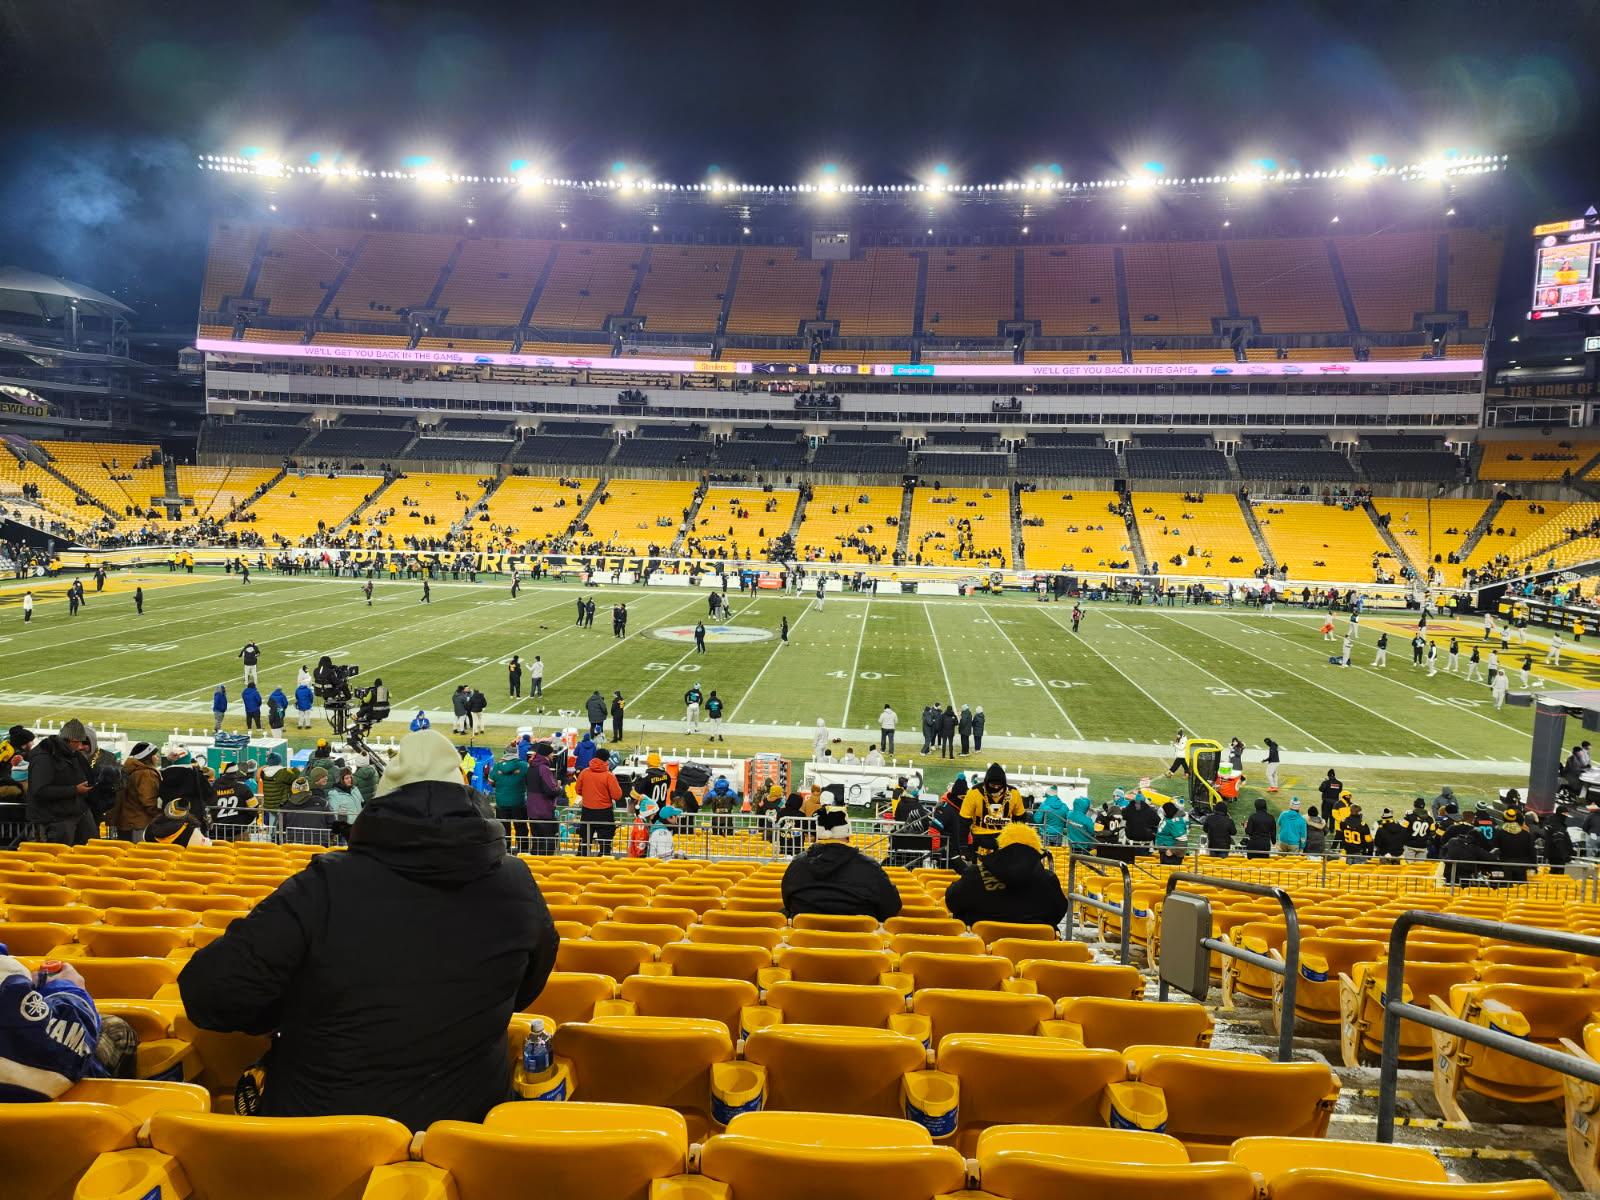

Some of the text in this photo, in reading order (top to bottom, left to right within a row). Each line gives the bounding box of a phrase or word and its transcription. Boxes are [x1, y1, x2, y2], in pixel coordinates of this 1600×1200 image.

[334, 348, 351, 357] GET
[355, 349, 373, 358] YOU
[376, 350, 400, 359] BACK
[402, 351, 412, 359] IN
[414, 352, 431, 360] THE
[1083, 366, 1102, 374] YOU
[1105, 366, 1130, 374] BACK
[1132, 366, 1143, 374] IN
[1145, 366, 1163, 374] THE
[1536, 384, 1573, 396] HOME
[350, 550, 543, 573] PITSBRGH
[217, 796, 239, 818] 22
[1343, 829, 1361, 844] 90
[1412, 821, 1429, 837] 90
